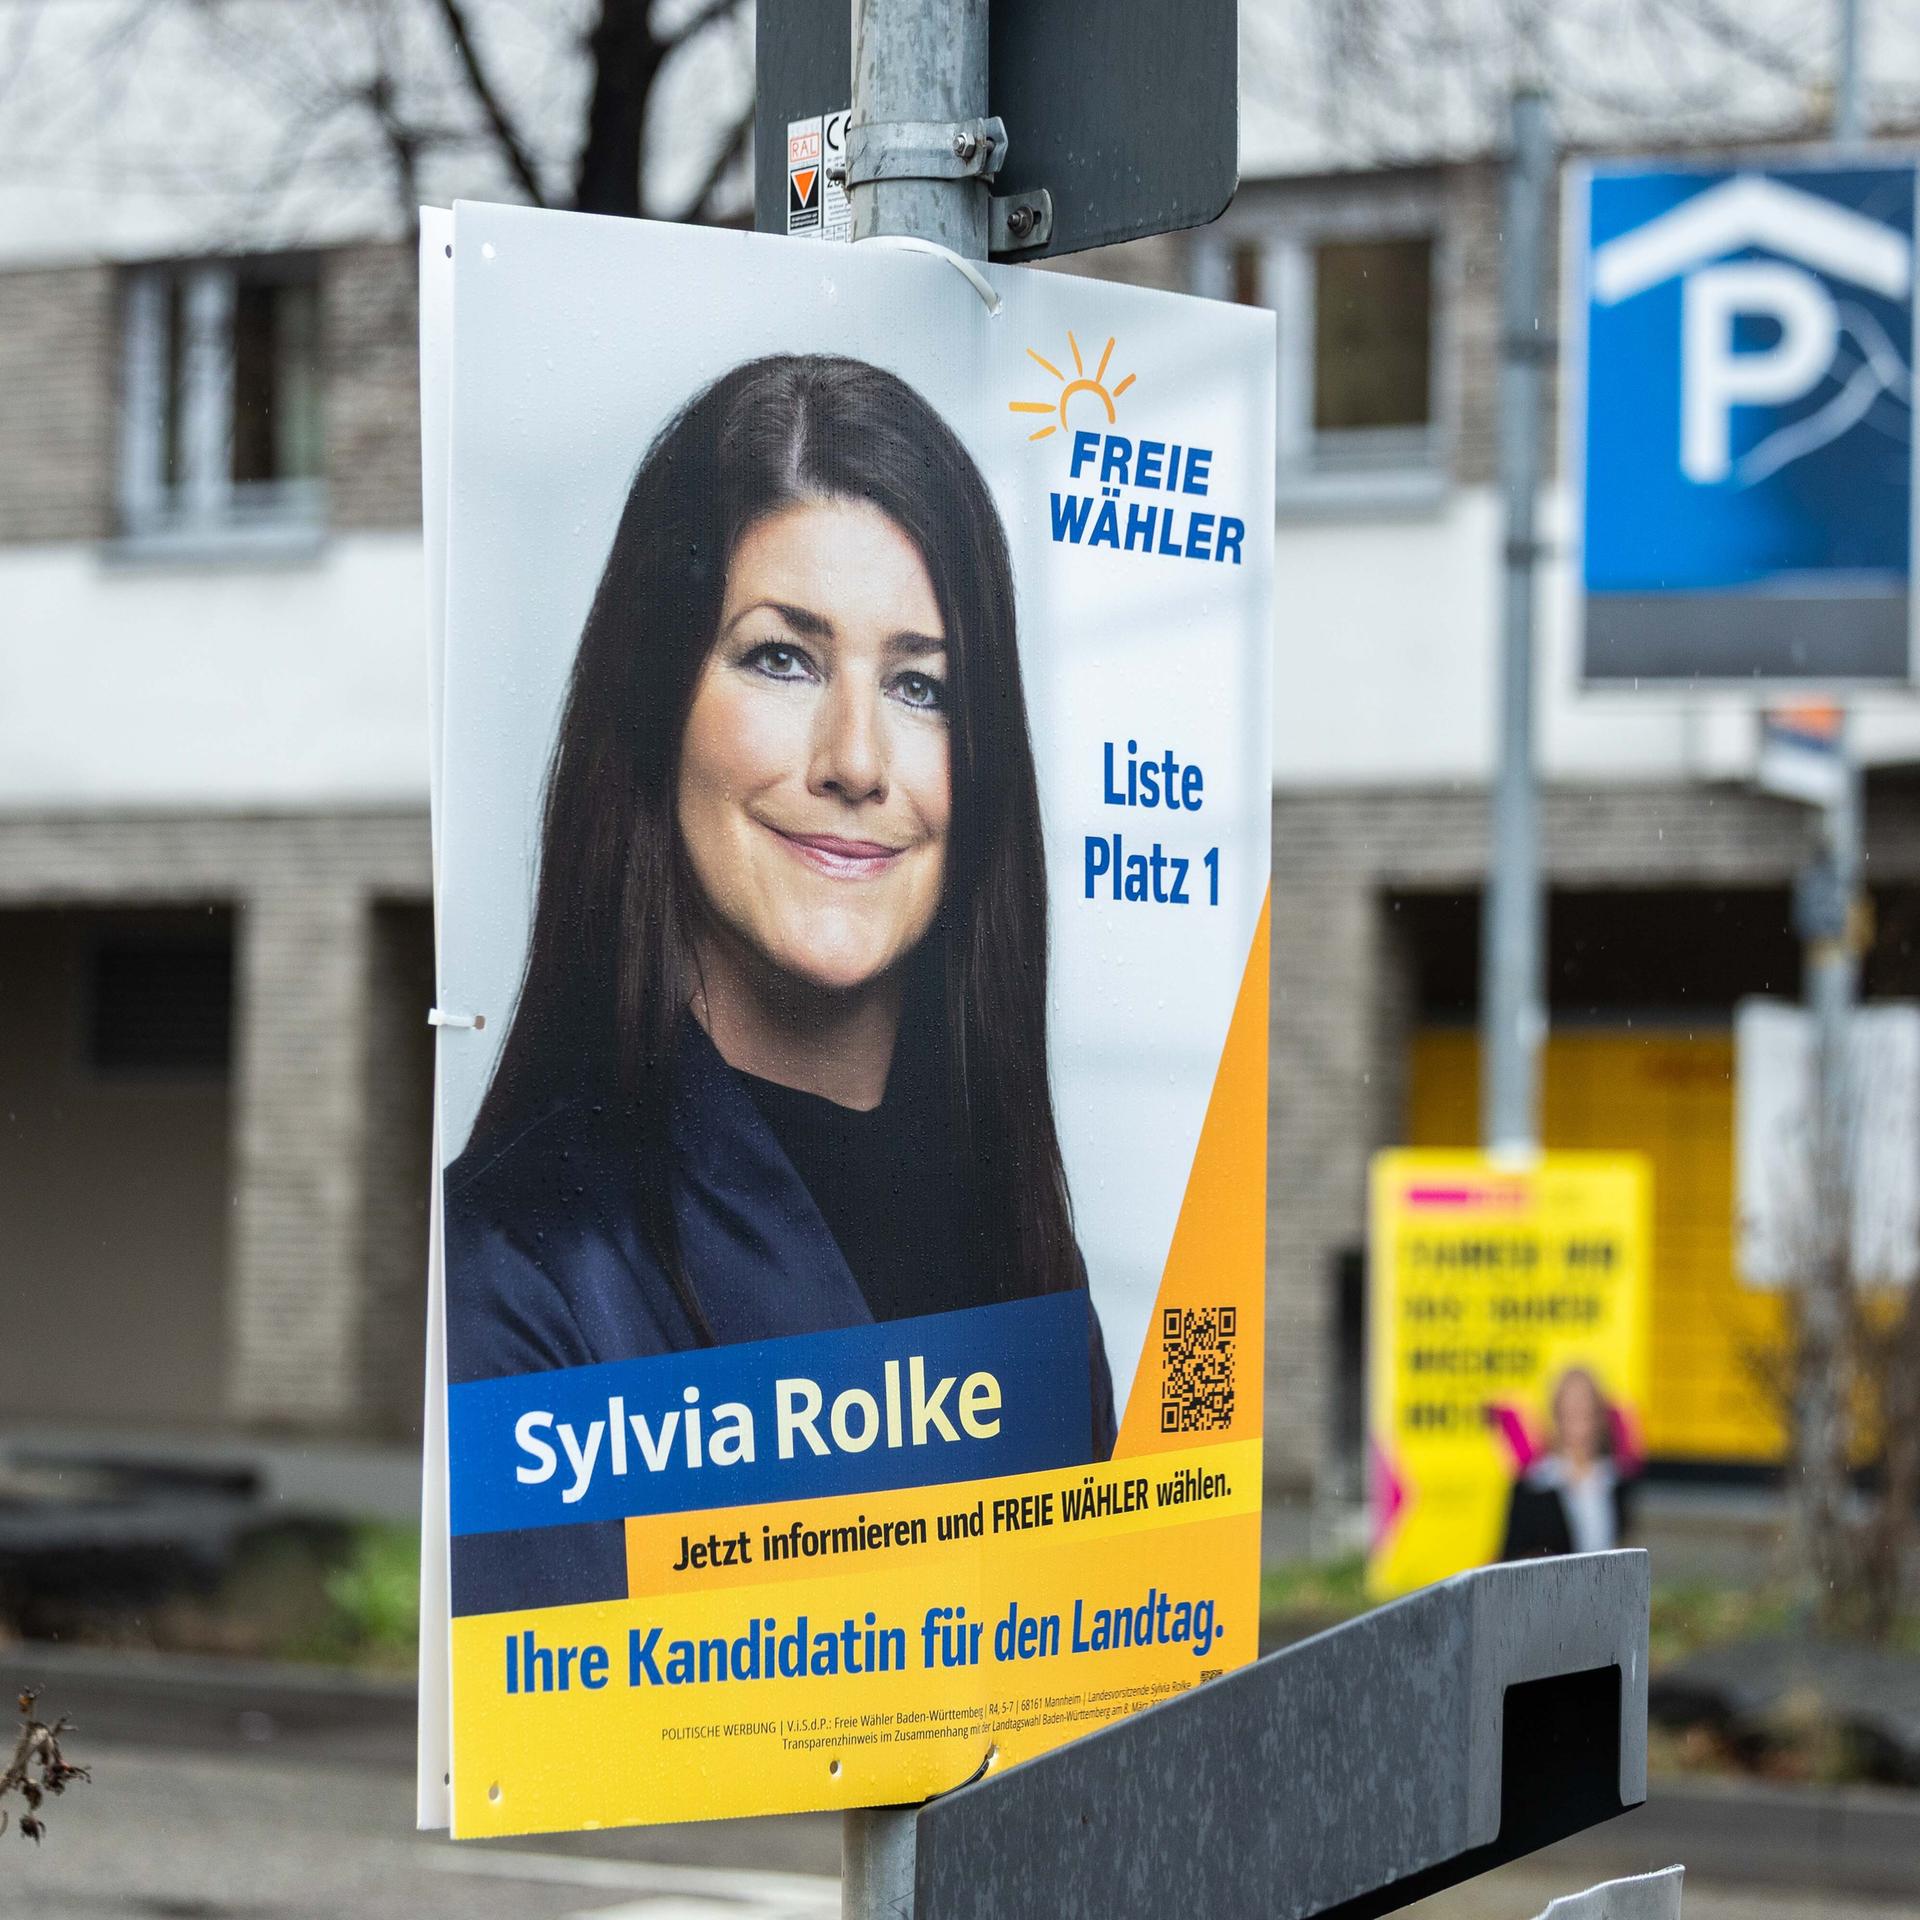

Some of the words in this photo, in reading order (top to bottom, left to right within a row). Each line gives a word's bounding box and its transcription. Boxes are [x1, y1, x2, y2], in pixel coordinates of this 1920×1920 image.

[792, 139, 817, 157] RAL
[1679, 259, 1841, 485] P
[1070, 430, 1213, 497] FREIE
[1050, 487, 1246, 565] WÄHLER
[1104, 739, 1203, 811] Liste
[1085, 833, 1189, 904] Platz
[1203, 847, 1219, 906] 1
[514, 1386, 755, 1504] Sylvia
[775, 1355, 1003, 1460] Rolke
[672, 1531, 753, 1571] Jetzt
[763, 1515, 927, 1561] informieren
[937, 1501, 984, 1541] und
[992, 1493, 1053, 1533] FREIE
[1061, 1476, 1149, 1523] WÄHLER
[1157, 1467, 1232, 1507] wählen.
[506, 1630, 609, 1694] Ihre
[628, 1611, 905, 1688] Kandidatin
[921, 1606, 984, 1668] für
[994, 1601, 1060, 1662] den
[1071, 1588, 1224, 1657] Landtag.
[661, 1725, 720, 1741] POLITISCHE
[723, 1721, 776, 1737] WERBUNG
[787, 1717, 832, 1732] V.i.S.d.P.:
[834, 1715, 858, 1729] Freie
[860, 1712, 894, 1727] Wähler
[896, 1705, 984, 1724] Baden-Württembeg
[1002, 1701, 1014, 1714] 5-7
[1021, 1698, 1043, 1711] 68161
[1045, 1694, 1081, 1708] Mannheim
[1088, 1684, 1149, 1702] Landesvorsitzende
[782, 1732, 878, 1752] Transparenzhinweis
[880, 1731, 892, 1743] im
[895, 1725, 969, 1742] Zusammenhang
[992, 1713, 1041, 1731] Landtagswahl
[1043, 1706, 1110, 1725] Baden-Württemberg
[1112, 1705, 1123, 1716] am
